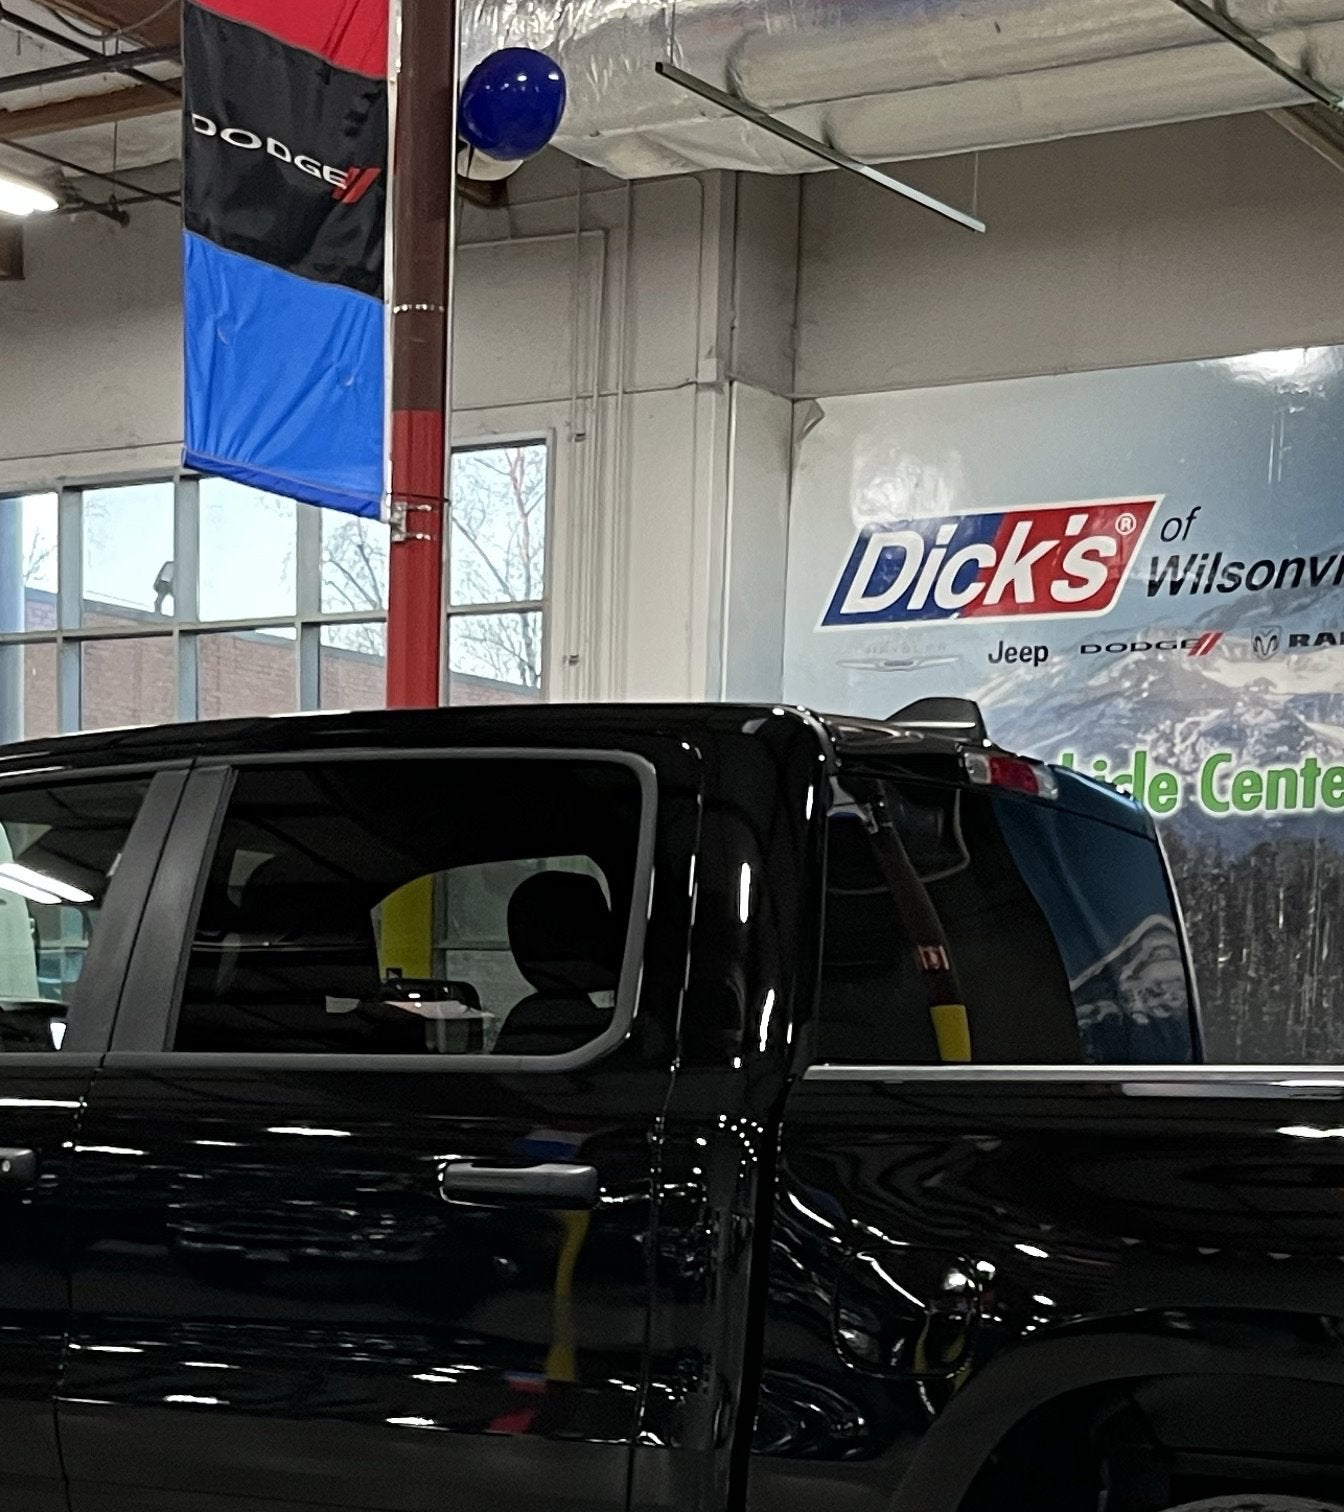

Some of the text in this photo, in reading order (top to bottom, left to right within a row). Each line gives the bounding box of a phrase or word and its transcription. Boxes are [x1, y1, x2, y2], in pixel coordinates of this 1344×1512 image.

[192, 113, 348, 190] DODGE
[1160, 506, 1201, 542] of
[988, 640, 1049, 667] Jeep
[1080, 637, 1200, 655] DODGE
